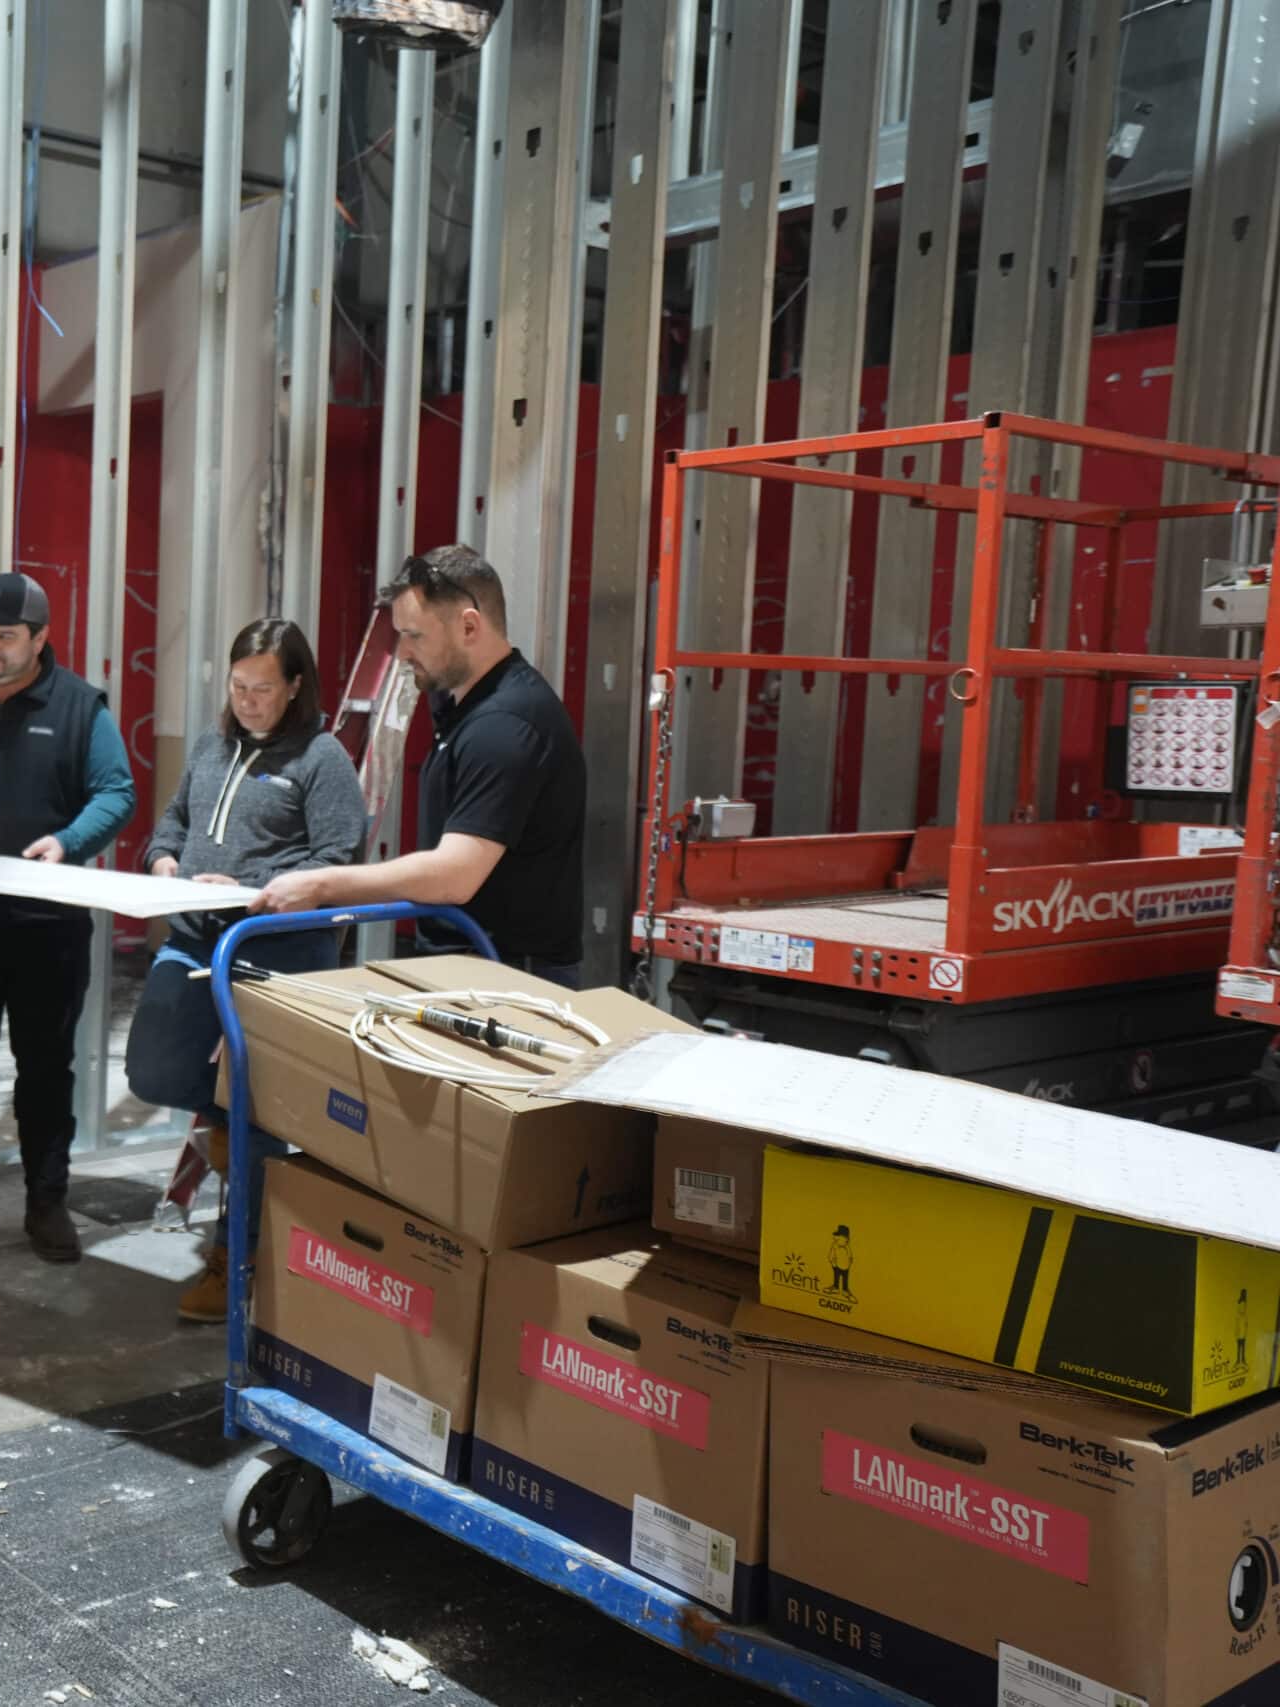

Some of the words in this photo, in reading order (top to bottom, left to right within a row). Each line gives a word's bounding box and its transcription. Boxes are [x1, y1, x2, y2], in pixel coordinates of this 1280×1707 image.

[992, 878, 1134, 934] SKYJACK
[332, 1097, 363, 1121] wren
[404, 1221, 464, 1259] Berk-Tek
[818, 1298, 853, 1314] CADDY
[666, 1317, 734, 1354] Berk-Te
[257, 1344, 301, 1384] RISER
[1058, 1360, 1169, 1397] nvent.com/caddy
[1019, 1421, 1136, 1472] Berk-Tek
[485, 1459, 541, 1505] RISER
[1191, 1443, 1266, 1498] Berk-Tek
[786, 1597, 863, 1652] RISER
